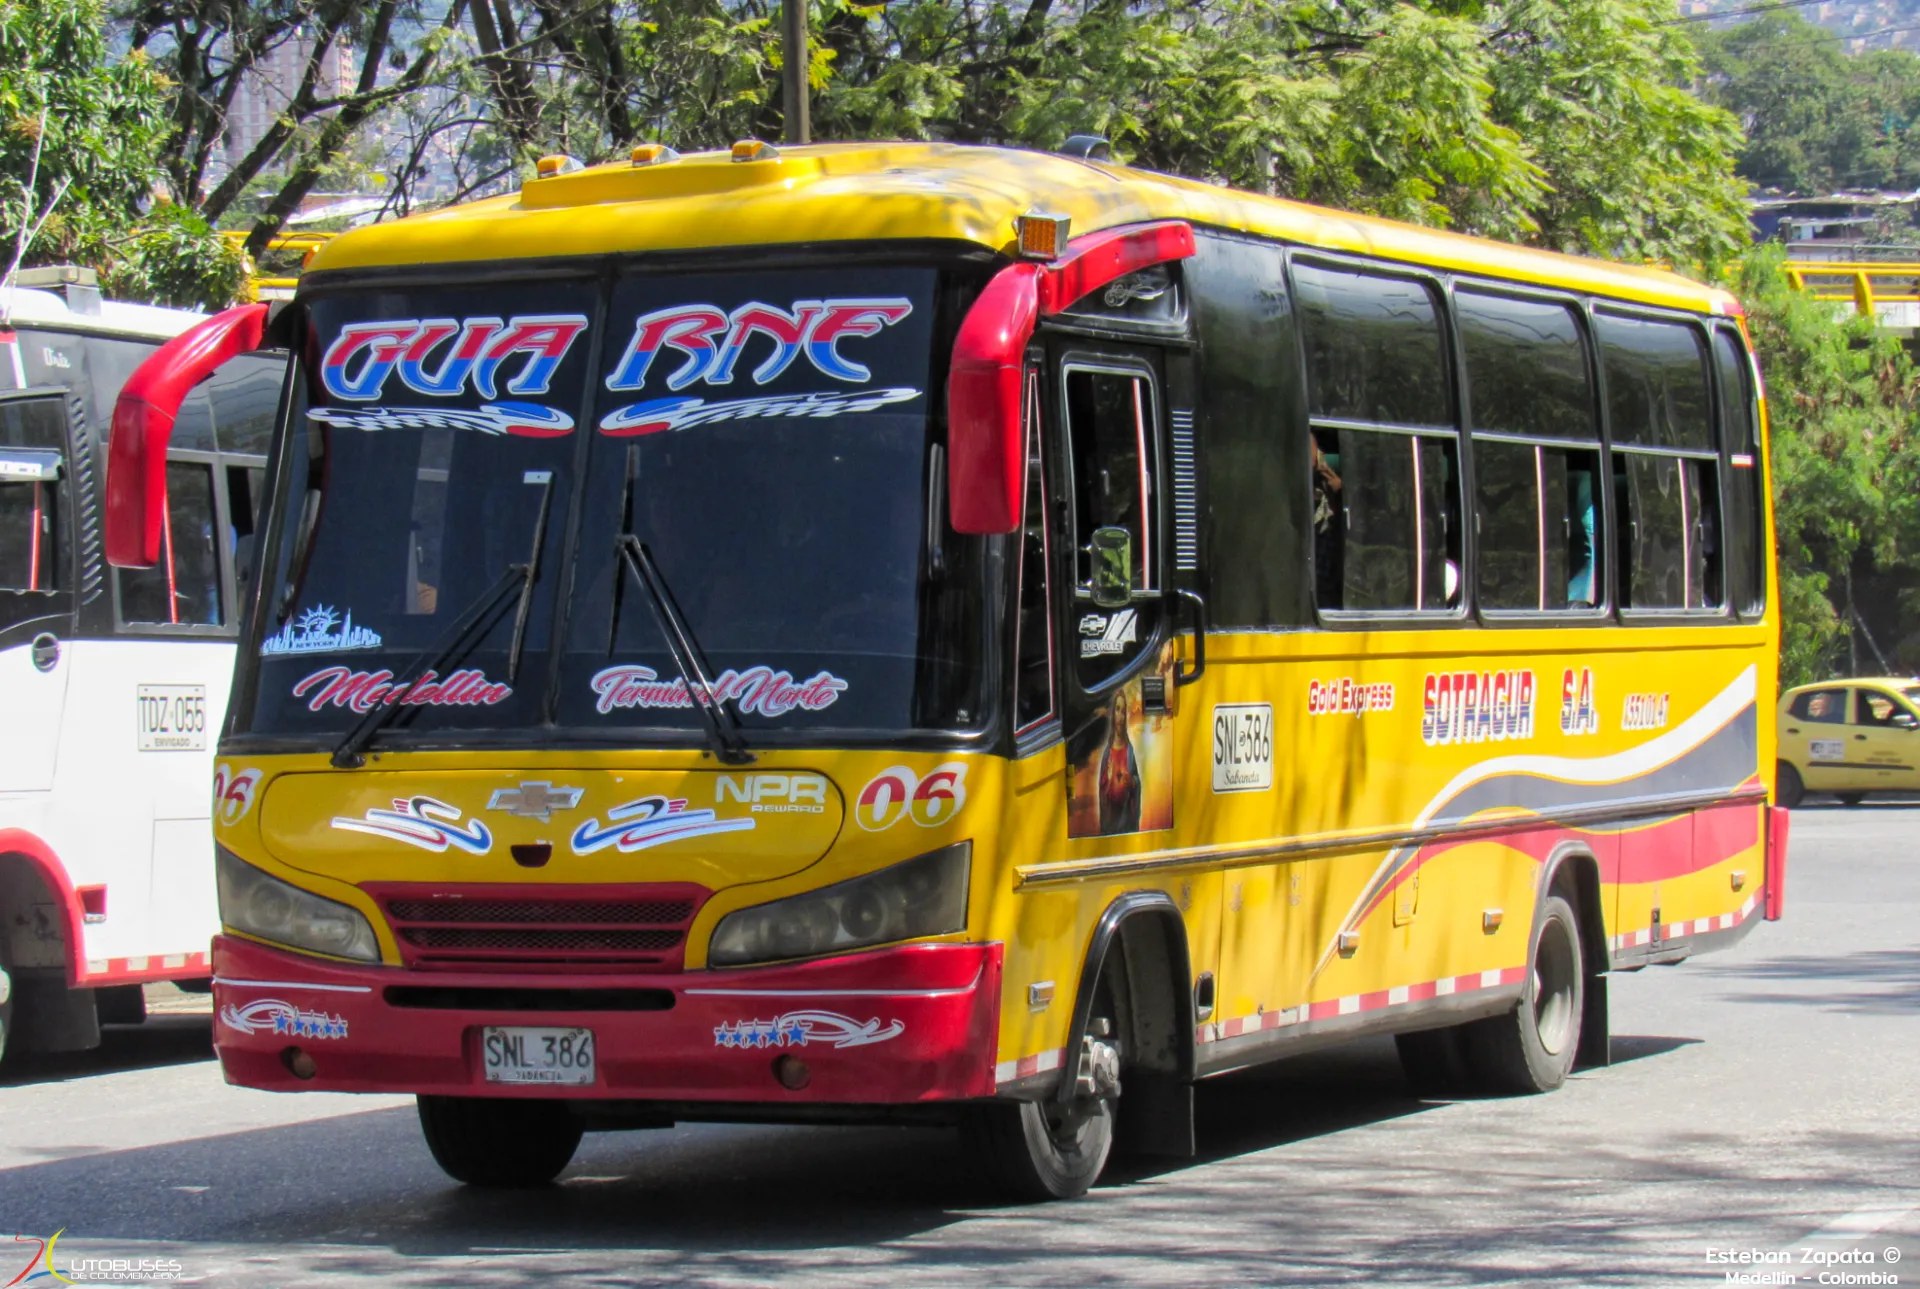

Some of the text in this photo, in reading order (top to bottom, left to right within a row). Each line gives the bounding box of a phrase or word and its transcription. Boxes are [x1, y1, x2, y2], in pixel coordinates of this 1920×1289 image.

[321, 297, 913, 400] GUA RNE
[730, 665, 849, 718] Norte
[1308, 676, 1394, 720] Gold Express
[1422, 671, 1546, 746] SOTRAGUR
[174, 695, 206, 733] 055
[154, 737, 191, 748] ENVIGADO
[1214, 712, 1270, 766] SNL 386
[715, 775, 827, 804] NPR
[751, 804, 825, 814] REWARD
[855, 762, 969, 832] 06
[486, 1034, 592, 1068] SNL 386
